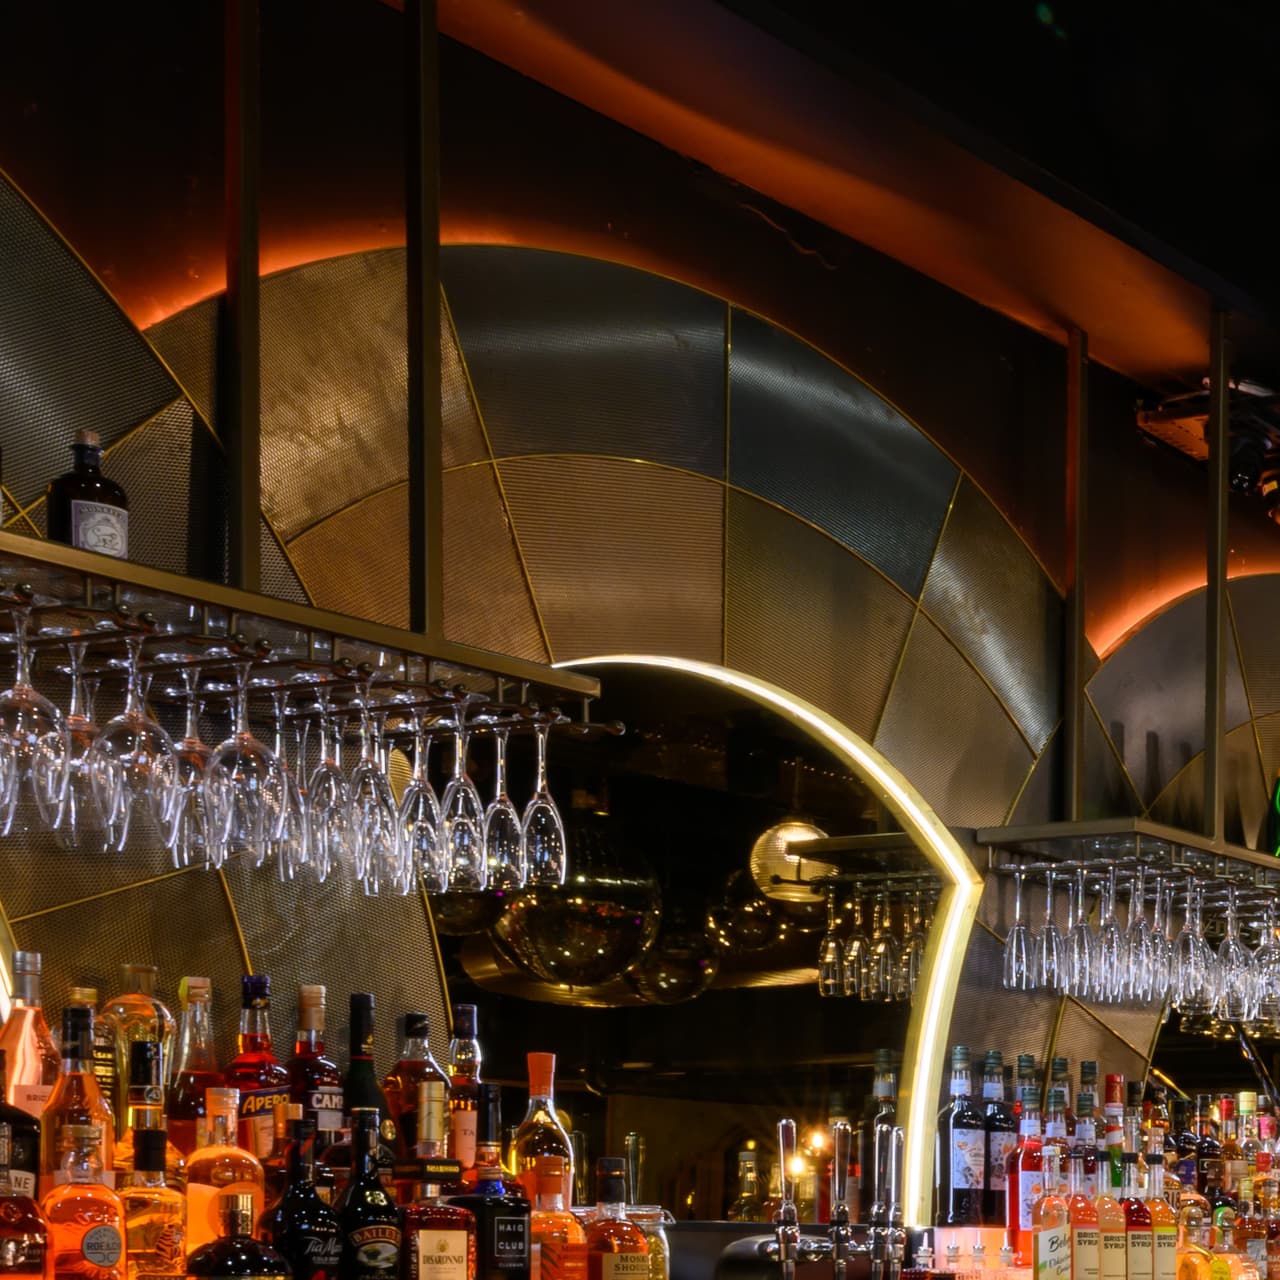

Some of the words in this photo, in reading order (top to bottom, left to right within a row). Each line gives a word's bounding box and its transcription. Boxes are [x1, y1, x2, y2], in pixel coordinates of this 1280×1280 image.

[242, 1093, 290, 1114] APERO
[498, 1224, 524, 1232] HAIG
[498, 1241, 524, 1250] CLUB
[422, 1255, 464, 1265] DISARONNO
